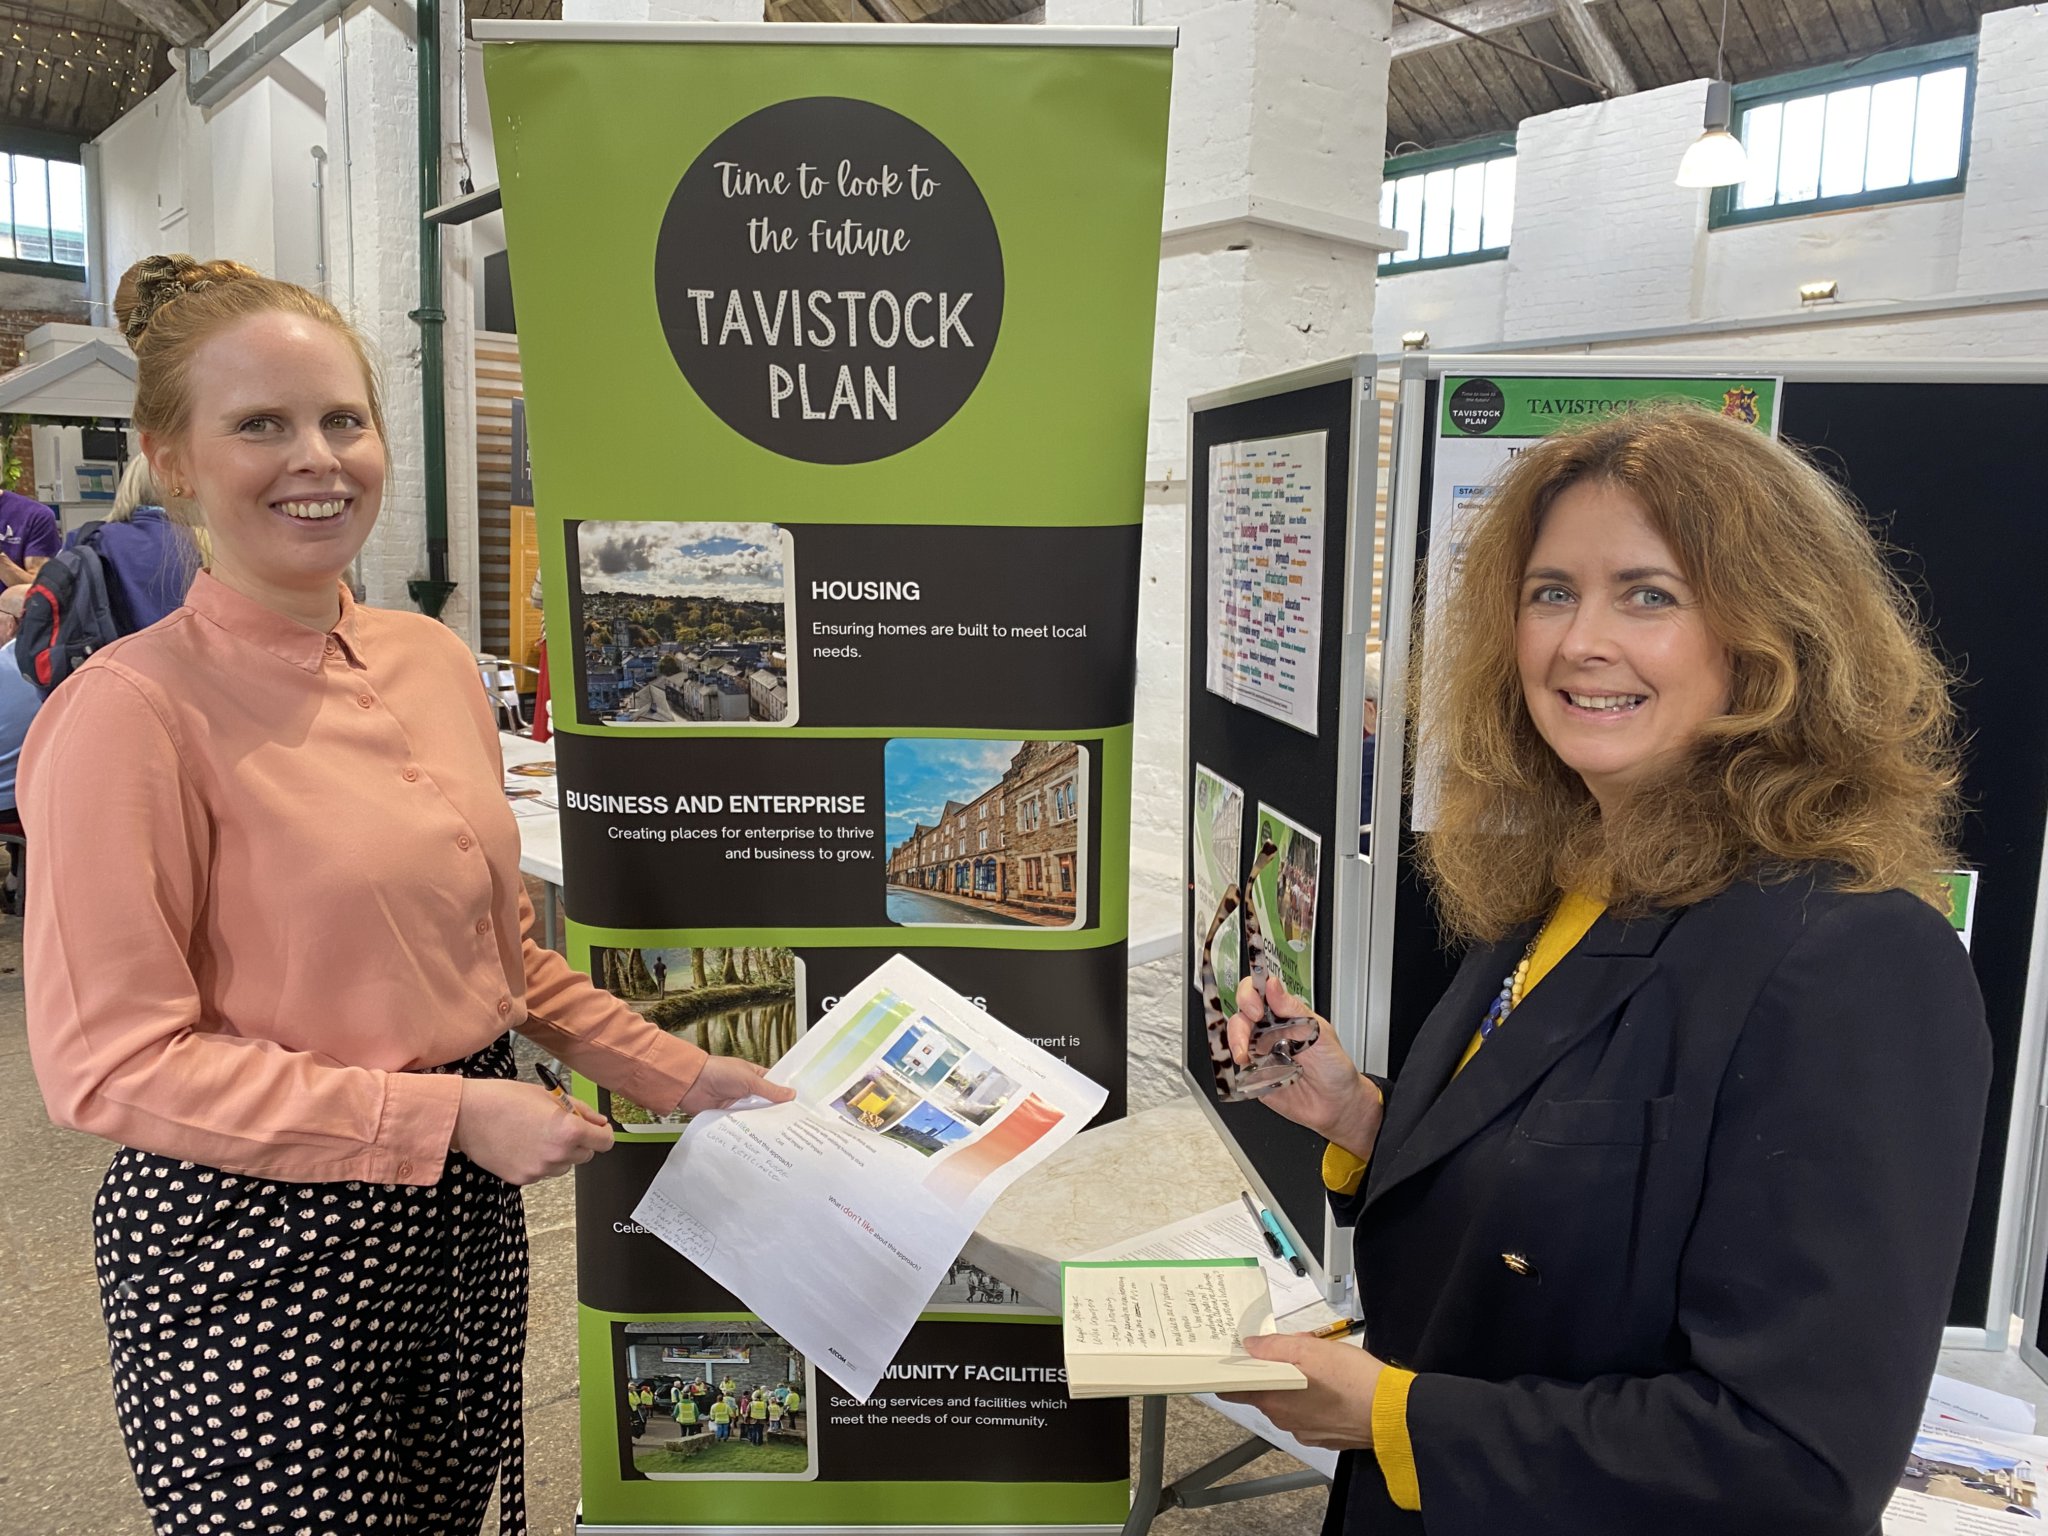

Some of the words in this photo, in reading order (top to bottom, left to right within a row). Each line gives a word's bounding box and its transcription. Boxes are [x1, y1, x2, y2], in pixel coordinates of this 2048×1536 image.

[713, 160, 790, 198] Time
[796, 162, 829, 199] to
[837, 159, 902, 197] look
[908, 164, 941, 200] to
[747, 217, 798, 253] the
[687, 288, 975, 349] TAVISTOCK
[769, 363, 897, 420] PLAN
[1527, 399, 1638, 414] TAVISTOCK
[812, 581, 920, 600] HOUSING
[812, 622, 874, 638] Ensuring
[878, 622, 927, 636] homes
[931, 625, 954, 636] are
[958, 623, 989, 637] built
[992, 624, 1007, 637] to
[1011, 625, 1048, 638] meet
[1052, 625, 1087, 638] local
[813, 645, 862, 658] needs.
[566, 790, 668, 814] BUSINESS
[675, 796, 723, 813] AND
[729, 795, 865, 813] ENTERPRISE
[608, 826, 667, 842] Creating
[670, 827, 717, 842] places
[721, 826, 741, 839] for
[744, 827, 815, 841] enterprise
[819, 827, 833, 839] to
[837, 826, 874, 839] thrive
[725, 848, 750, 860] and
[754, 848, 815, 860] business
[819, 849, 833, 860] to
[837, 850, 874, 862] grow.
[1263, 938, 1298, 975] COMMUNITY
[1069, 1035, 1080, 1046] is
[768, 1148, 793, 1169] approach?
[827, 1194, 842, 1208] What
[842, 1205, 863, 1224] don't
[861, 1219, 876, 1234] like
[873, 1231, 889, 1245] about
[887, 1242, 897, 1253] this
[895, 1250, 921, 1272] approach?
[881, 1364, 957, 1379] MUNITY
[964, 1366, 1068, 1382] FACILITIES
[890, 1397, 943, 1407] services
[947, 1397, 971, 1407] and
[974, 1397, 1027, 1408] facilities
[1030, 1398, 1067, 1409] which
[831, 1414, 863, 1424] meet
[867, 1413, 888, 1424] the
[891, 1413, 931, 1424] needs
[935, 1413, 948, 1424] of
[951, 1415, 971, 1425] our
[975, 1415, 1048, 1428] community.
